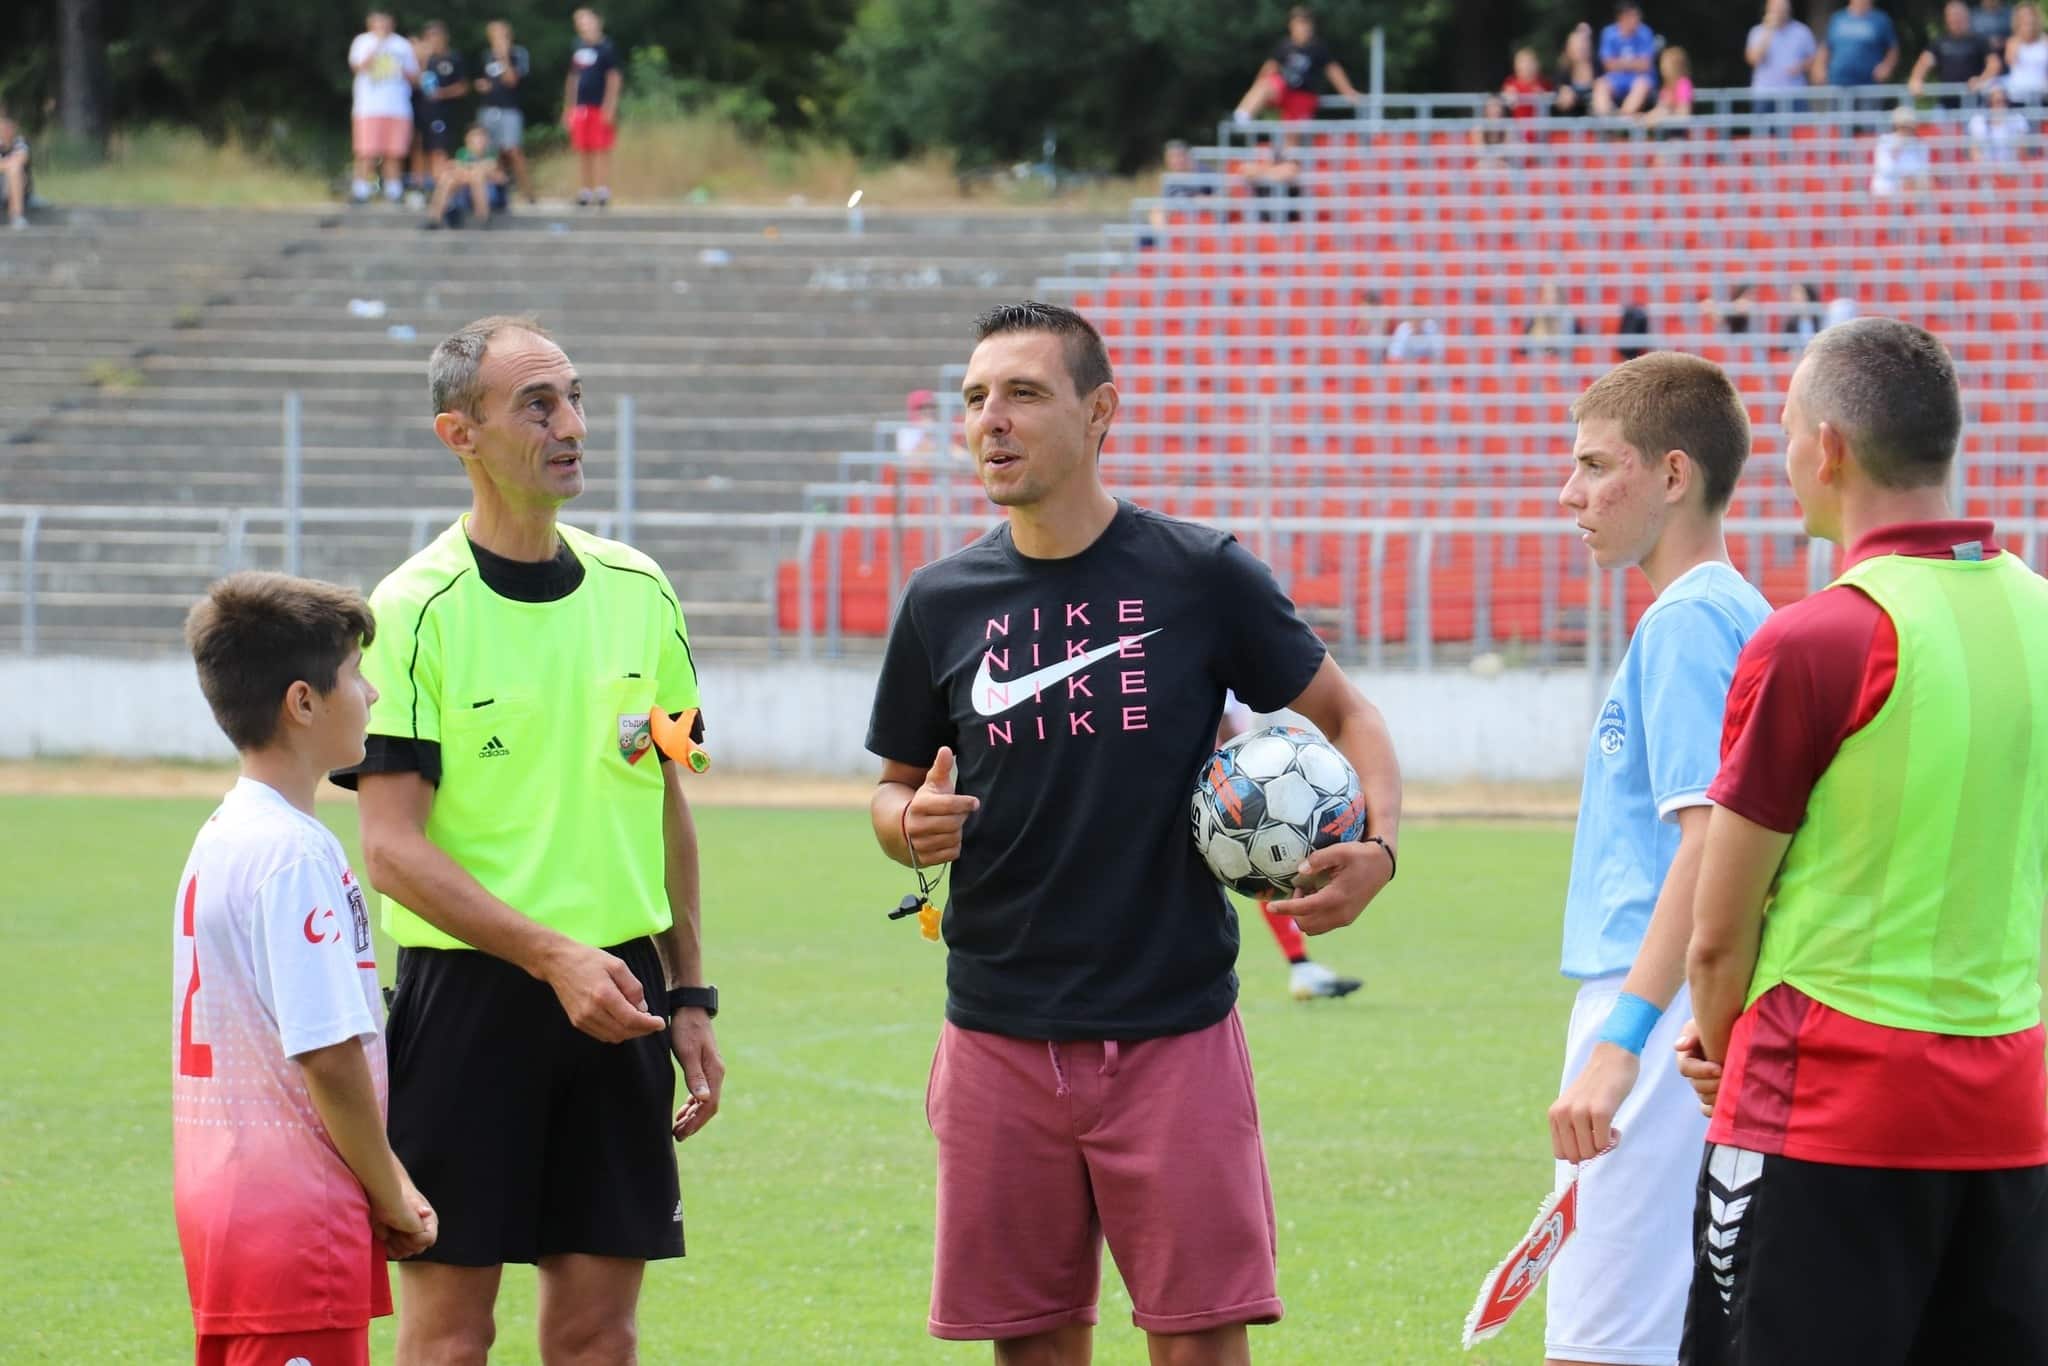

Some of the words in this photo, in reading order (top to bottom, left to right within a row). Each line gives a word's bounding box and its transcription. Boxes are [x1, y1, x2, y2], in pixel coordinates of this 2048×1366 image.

[985, 600, 1145, 640] NIKE
[984, 635, 1146, 673] NIKE
[986, 670, 1148, 709] NIKE
[987, 706, 1149, 747] NIKE
[479, 749, 510, 759] adidas
